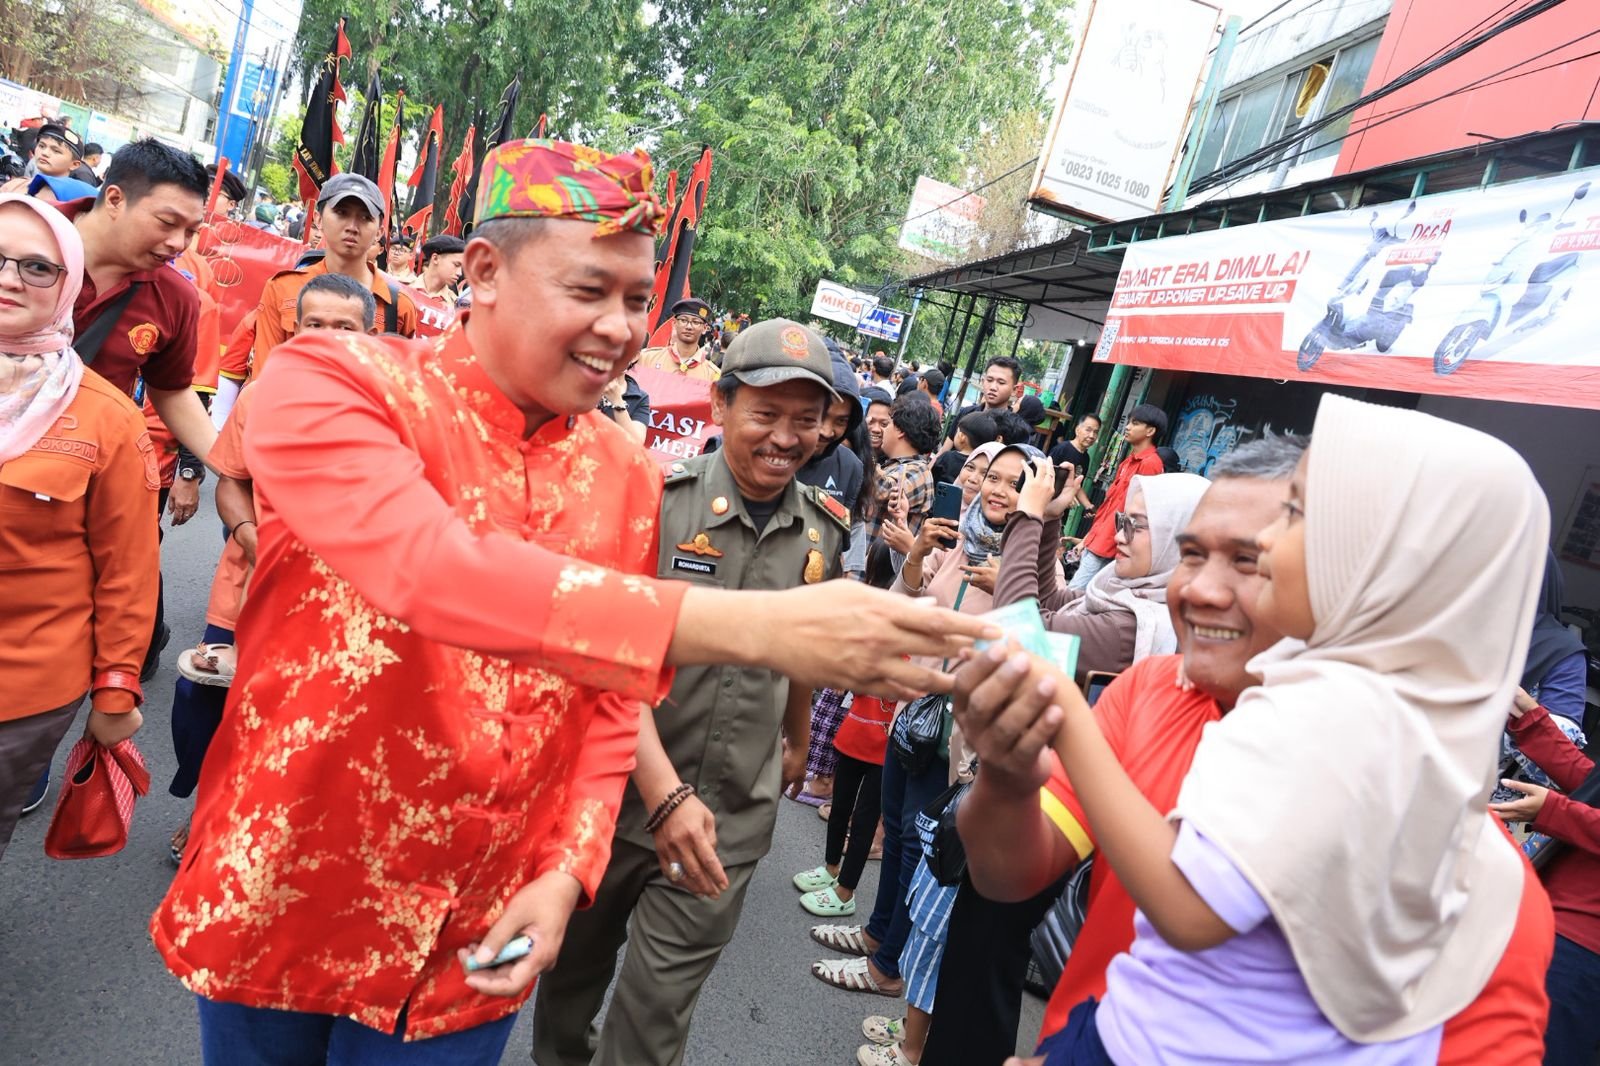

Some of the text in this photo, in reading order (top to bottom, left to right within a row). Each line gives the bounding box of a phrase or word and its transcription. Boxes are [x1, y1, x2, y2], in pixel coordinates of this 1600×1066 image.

[1066, 161, 1150, 199] 0823 1025 1080
[1117, 250, 1310, 288] SMART ERA DIMULAI
[1116, 290, 1151, 306] SMART
[1264, 282, 1288, 299] UP
[867, 309, 900, 327] JNE
[34, 438, 95, 459] OKOPIM
